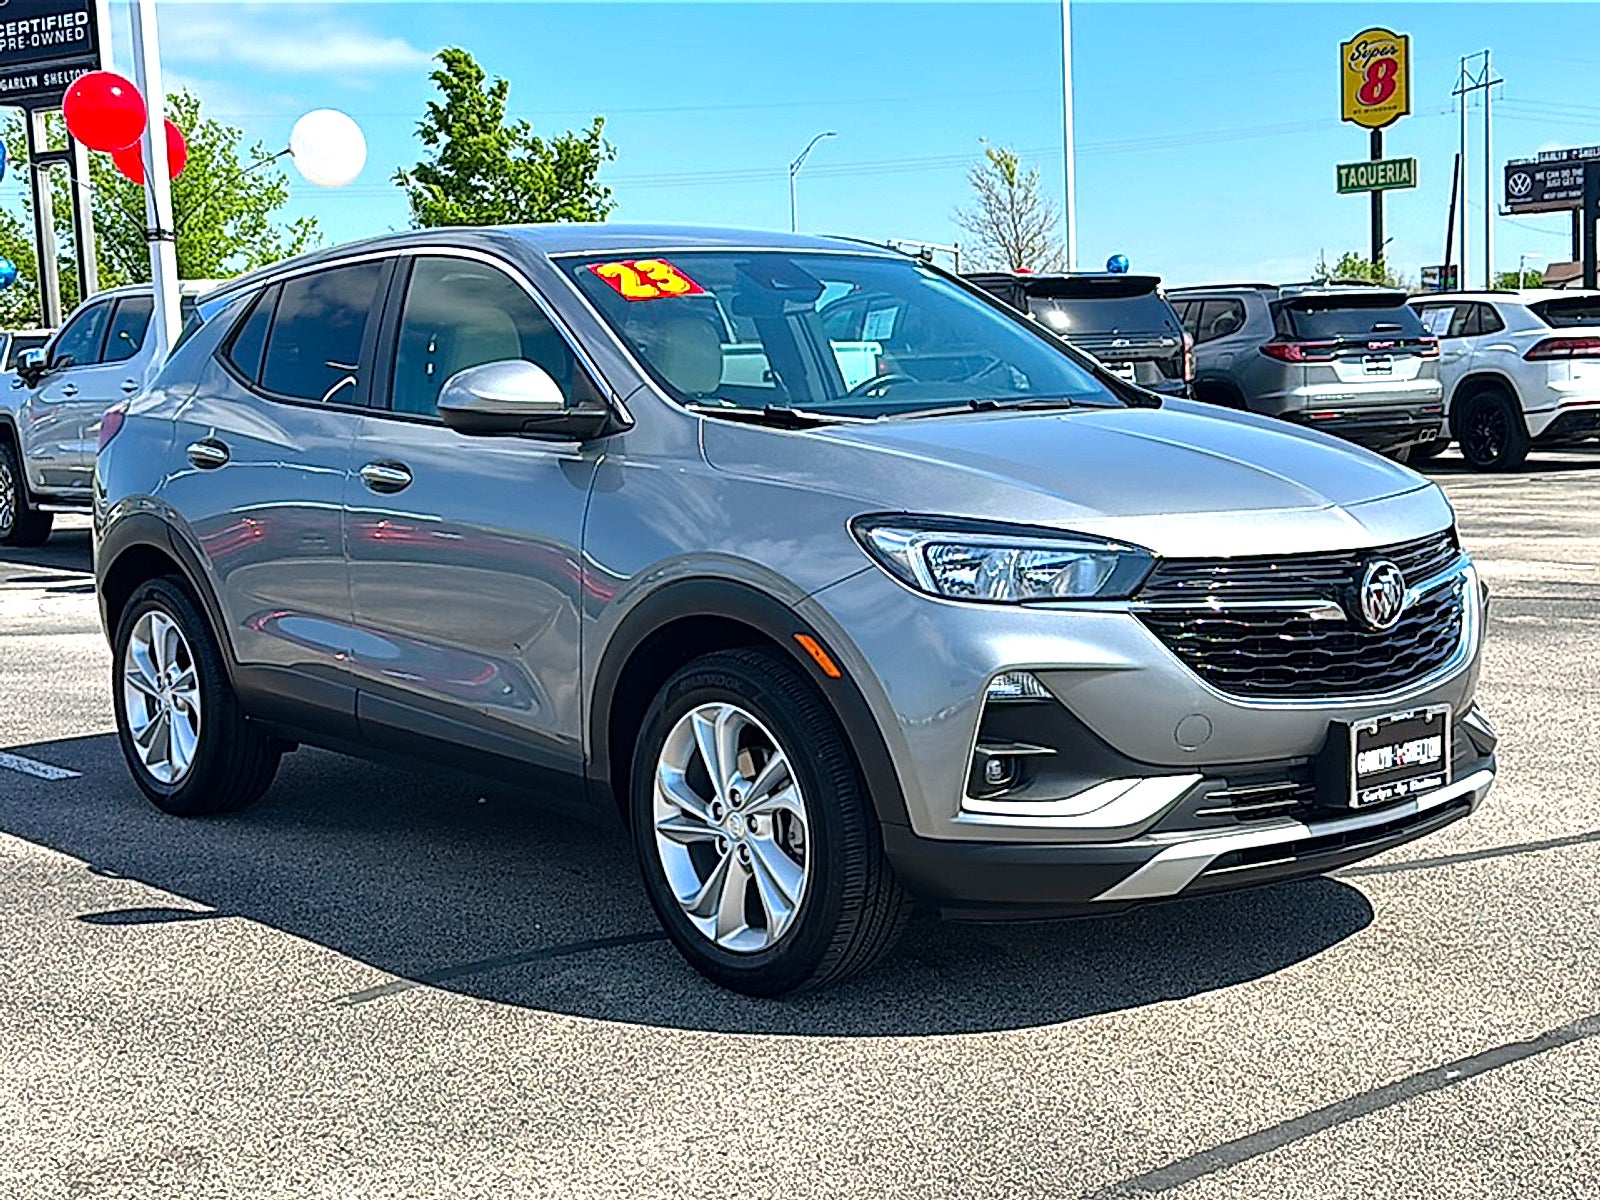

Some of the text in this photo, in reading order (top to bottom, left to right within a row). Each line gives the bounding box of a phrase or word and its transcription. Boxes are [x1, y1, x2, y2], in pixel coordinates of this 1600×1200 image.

[0, 11, 88, 38] CERTIFIED
[0, 26, 85, 52] PRE-OWNED
[1350, 40, 1398, 69] Super
[1356, 57, 1399, 106] 8
[1339, 161, 1411, 188] TAQUERIA
[597, 259, 691, 298] 23
